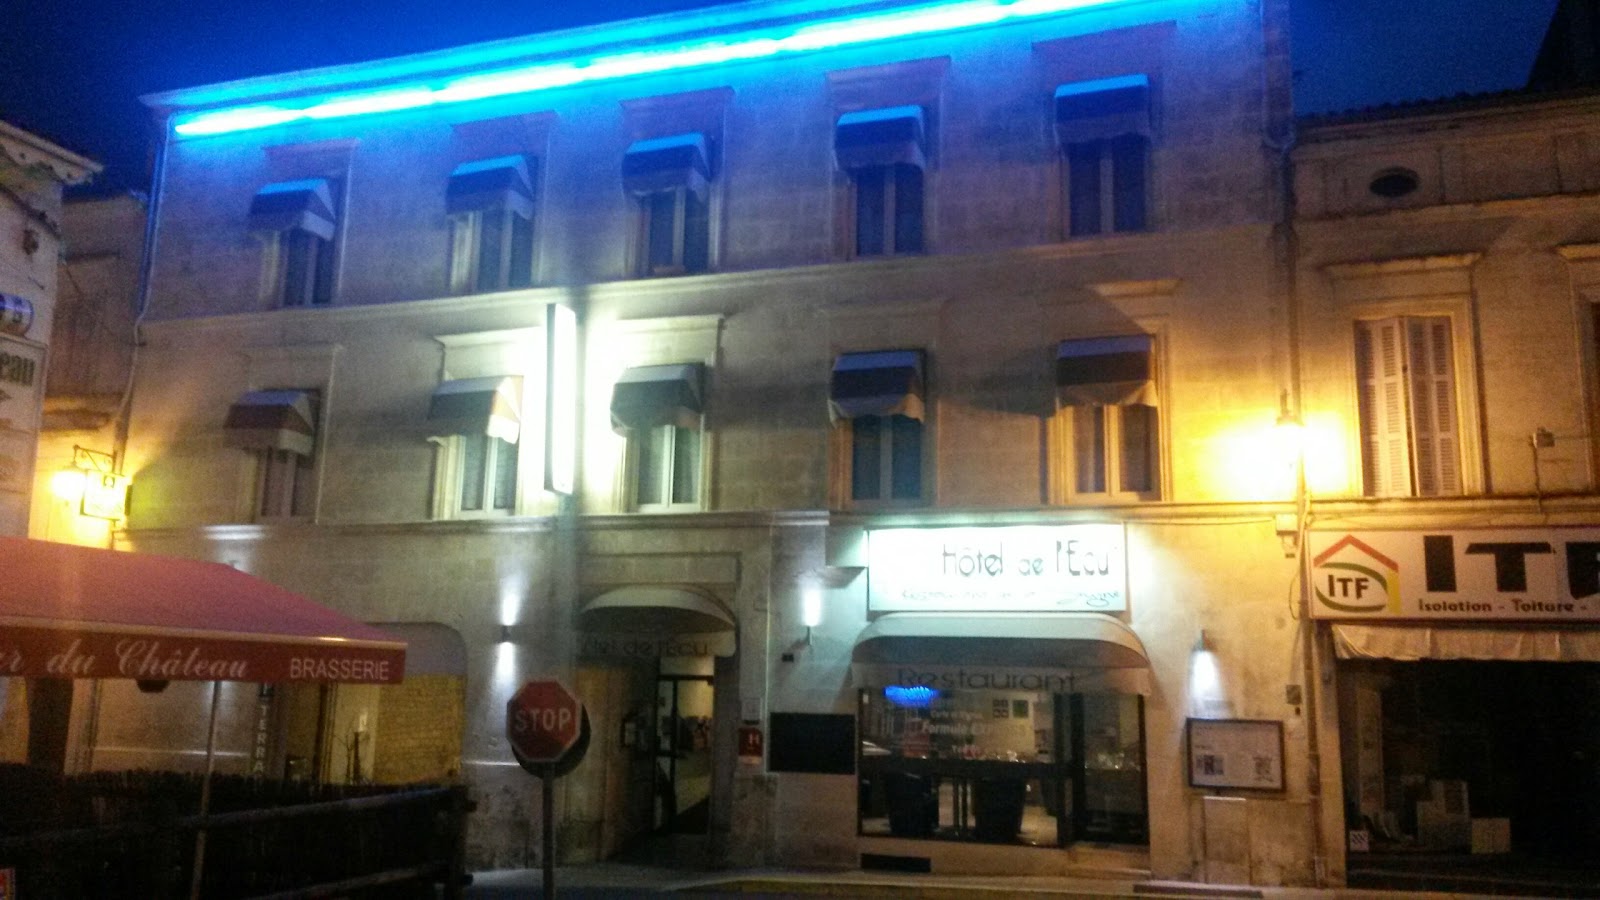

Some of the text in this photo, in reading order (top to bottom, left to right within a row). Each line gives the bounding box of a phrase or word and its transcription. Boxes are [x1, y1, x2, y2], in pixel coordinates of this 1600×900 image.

[942, 541, 1004, 577] Hôtel
[1327, 574, 1370, 600] ITF
[1417, 598, 1575, 613] Isolation Toiture
[47, 638, 96, 674] du
[116, 638, 248, 678] Château
[289, 657, 390, 681] BRASSERIE
[897, 667, 1078, 691] Restaurant
[514, 708, 572, 733] STOP
